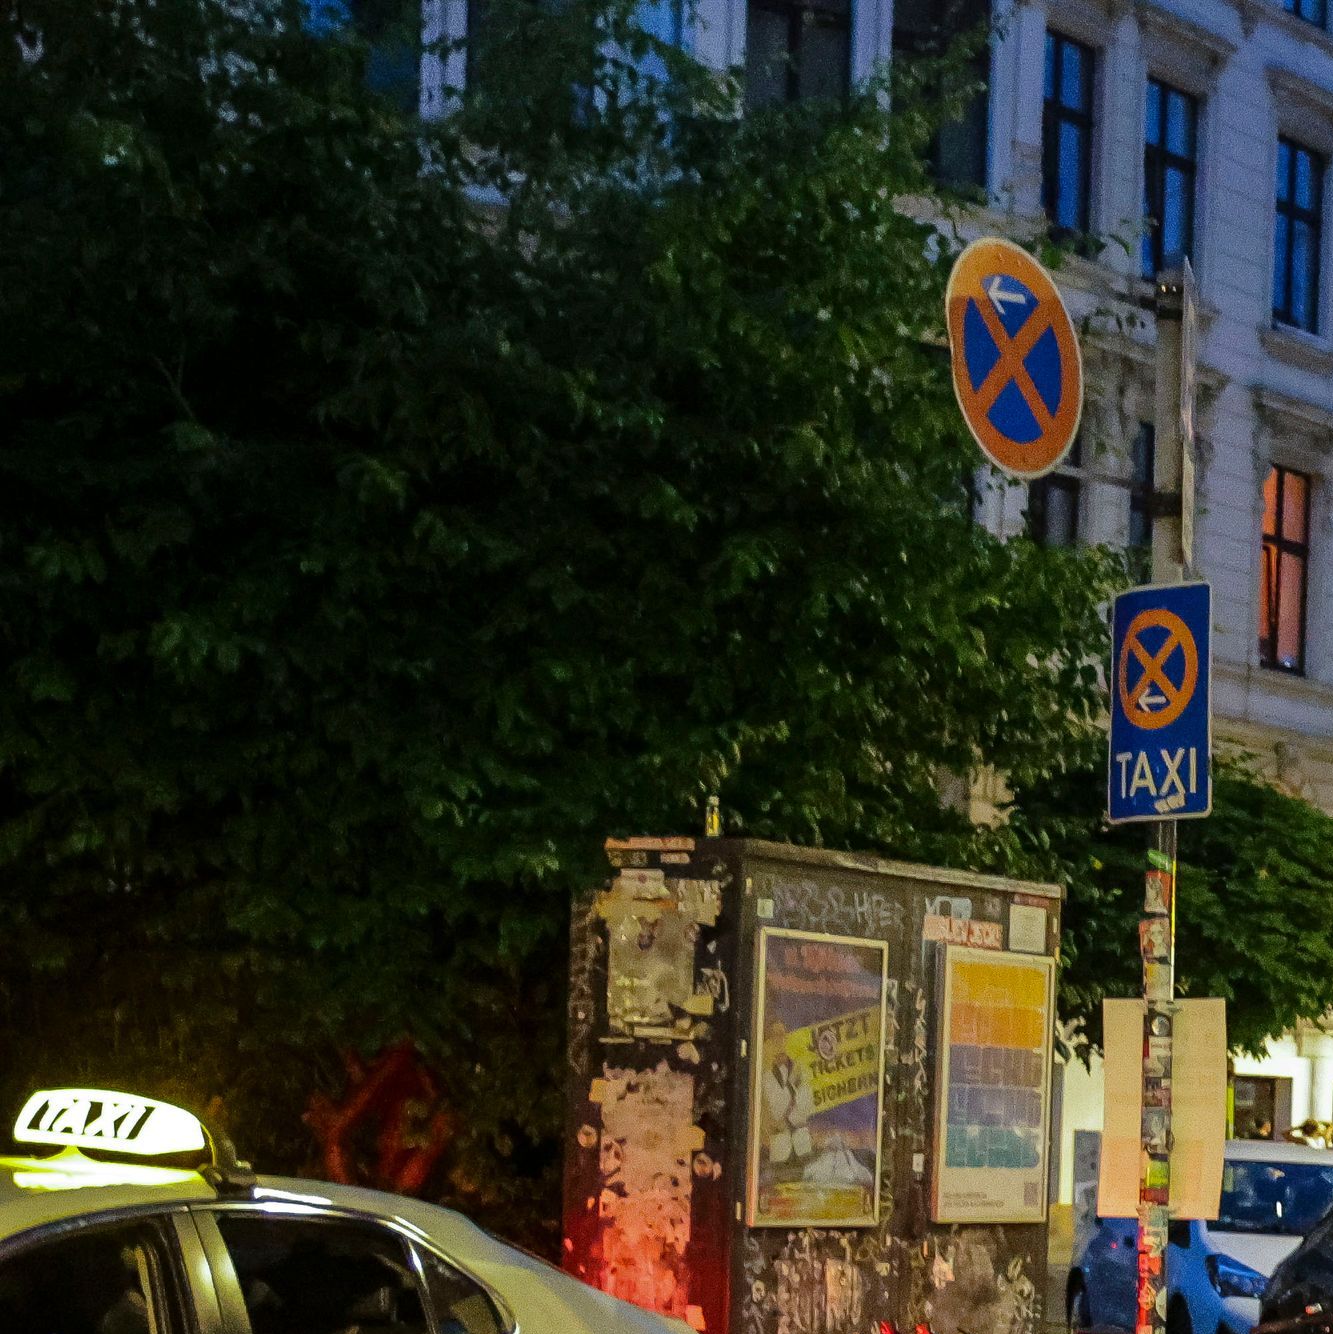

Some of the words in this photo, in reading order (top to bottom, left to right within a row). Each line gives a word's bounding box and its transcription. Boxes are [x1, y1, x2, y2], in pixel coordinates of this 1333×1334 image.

[1115, 746, 1197, 799] TAXI
[810, 1011, 872, 1051] JTZT
[27, 1099, 156, 1140] TAXI
